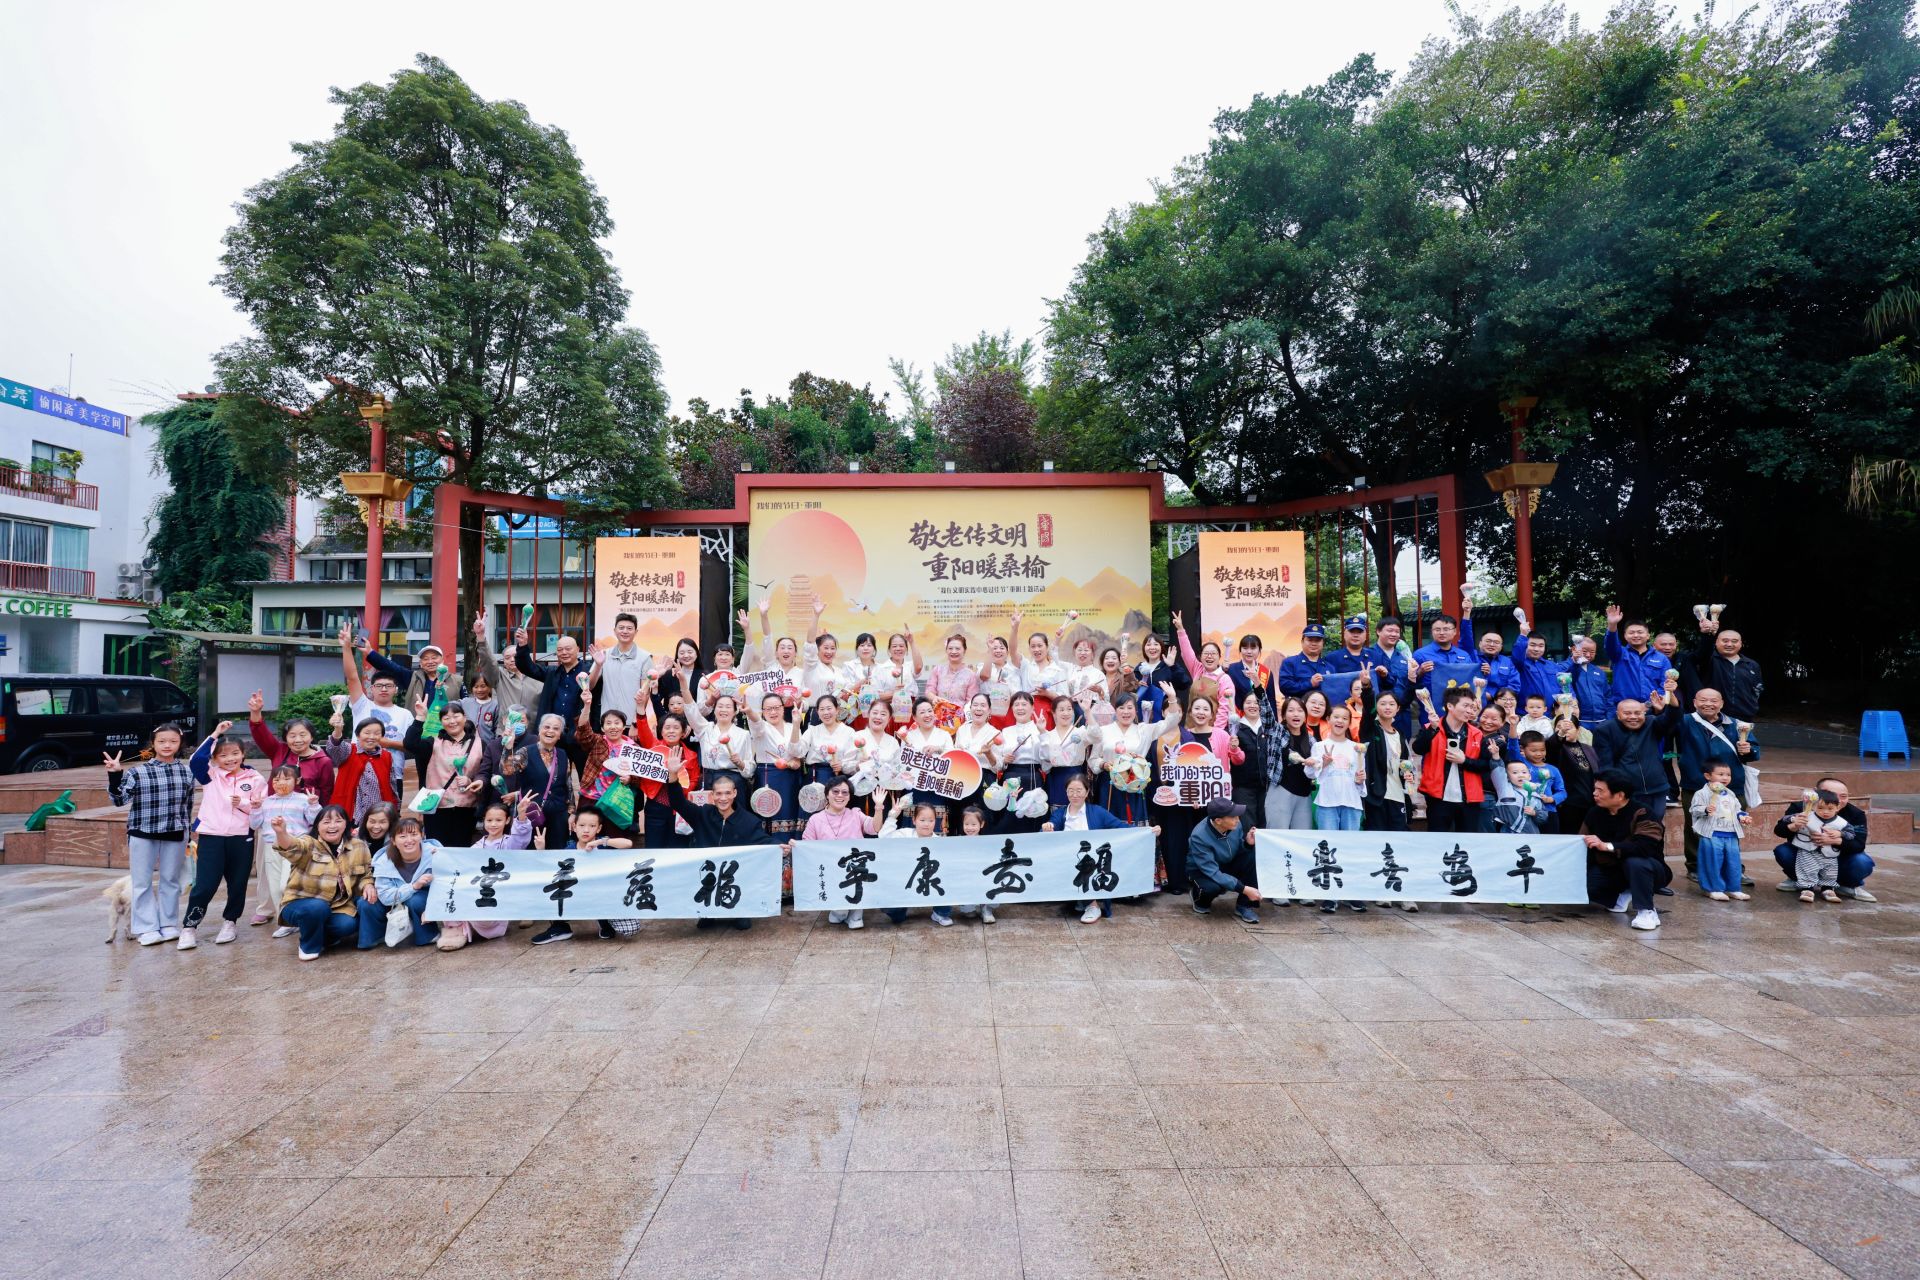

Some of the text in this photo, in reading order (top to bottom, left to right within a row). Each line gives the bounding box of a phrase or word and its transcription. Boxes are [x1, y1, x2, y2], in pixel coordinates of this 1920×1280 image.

[908, 520, 1027, 549] 敬老传文明
[922, 552, 1051, 582] 重阳暖桑榆
[1213, 565, 1279, 583] 敬老传文明
[609, 570, 674, 588] 敬老传文明
[616, 588, 687, 606] 重阳暖桑榆
[1221, 583, 1292, 600] 重阳暖桑榆
[6, 599, 73, 618] COFFEE
[621, 745, 664, 767] 家有好风
[900, 747, 951, 775] 敬老传文明
[1161, 765, 1223, 780] 我们的节日
[915, 771, 965, 799] 重阳暖桑榆
[1179, 780, 1224, 805] 重阳
